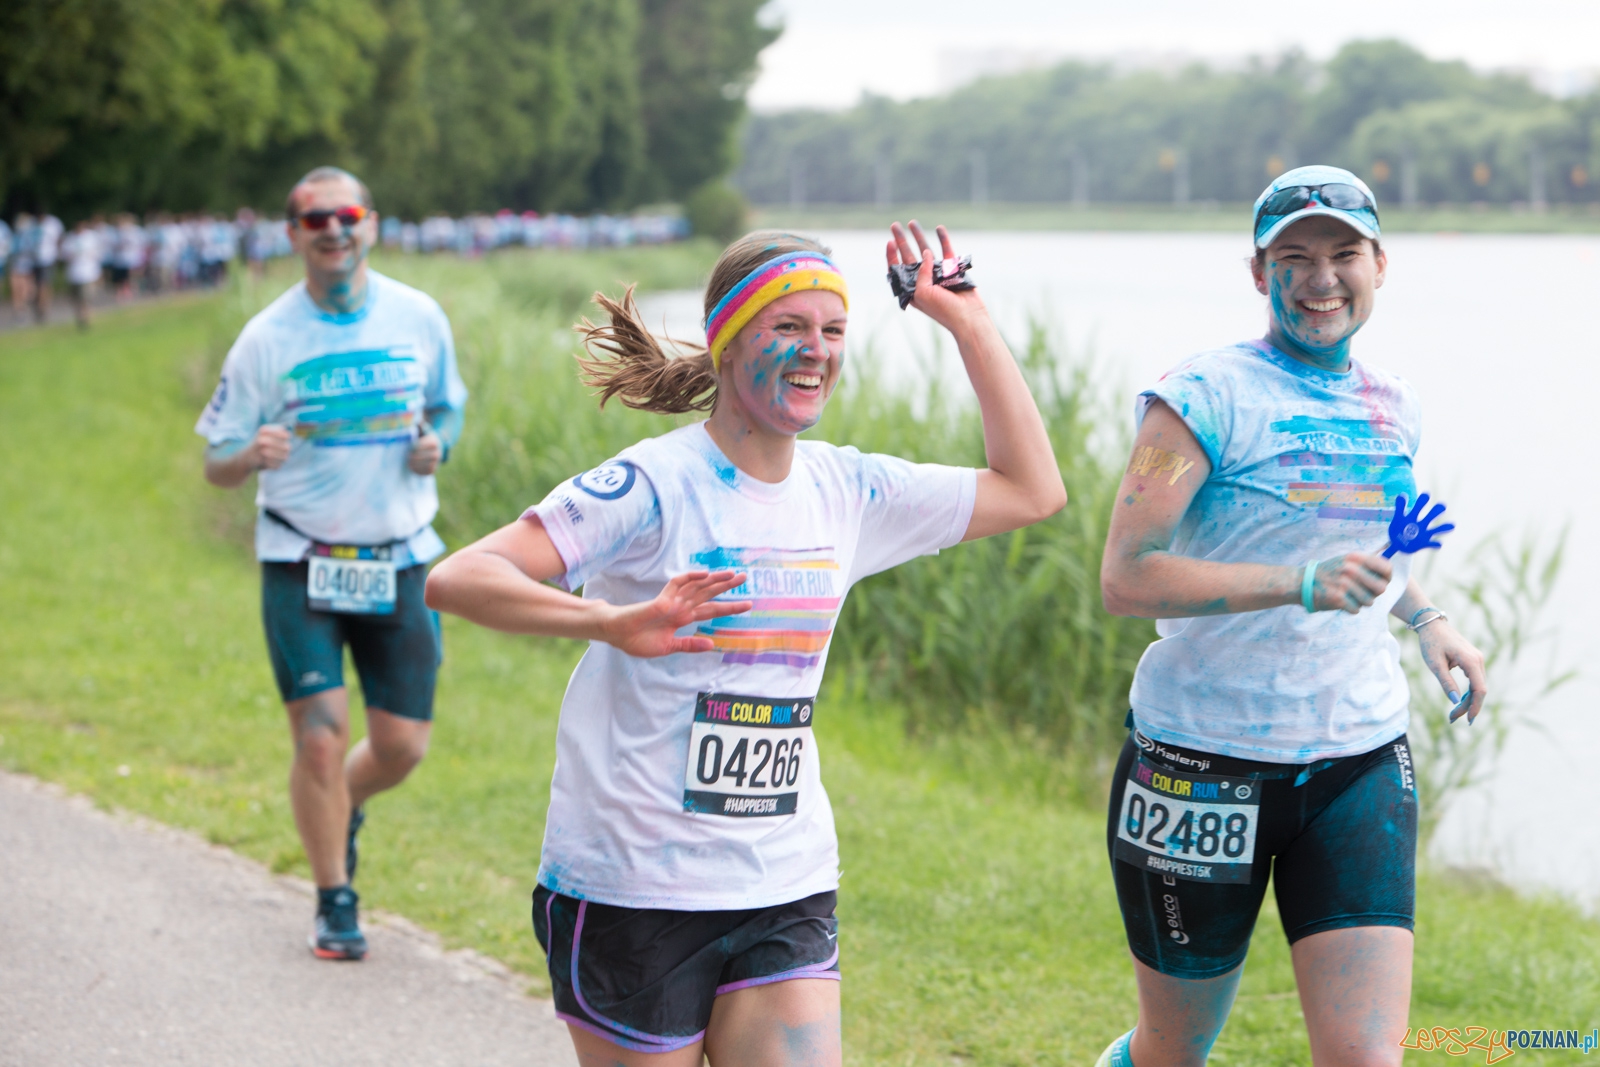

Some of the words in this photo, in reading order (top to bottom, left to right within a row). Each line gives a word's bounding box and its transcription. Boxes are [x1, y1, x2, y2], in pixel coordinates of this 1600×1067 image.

[315, 563, 389, 597] 04006
[752, 568, 804, 596] COLOR
[805, 569, 836, 597] RUN
[706, 700, 731, 720] THE
[731, 702, 772, 724] COLOR
[771, 706, 793, 725] RUN
[696, 734, 803, 789] 04266
[1155, 744, 1211, 772] Kalenji
[1136, 762, 1153, 786] THE
[1152, 772, 1192, 797] COLOR
[1192, 782, 1219, 799] RUN
[724, 796, 779, 814] #HAPPIEST5K
[1126, 793, 1248, 858] 02488
[1146, 855, 1213, 878] #HAPPIEST5K
